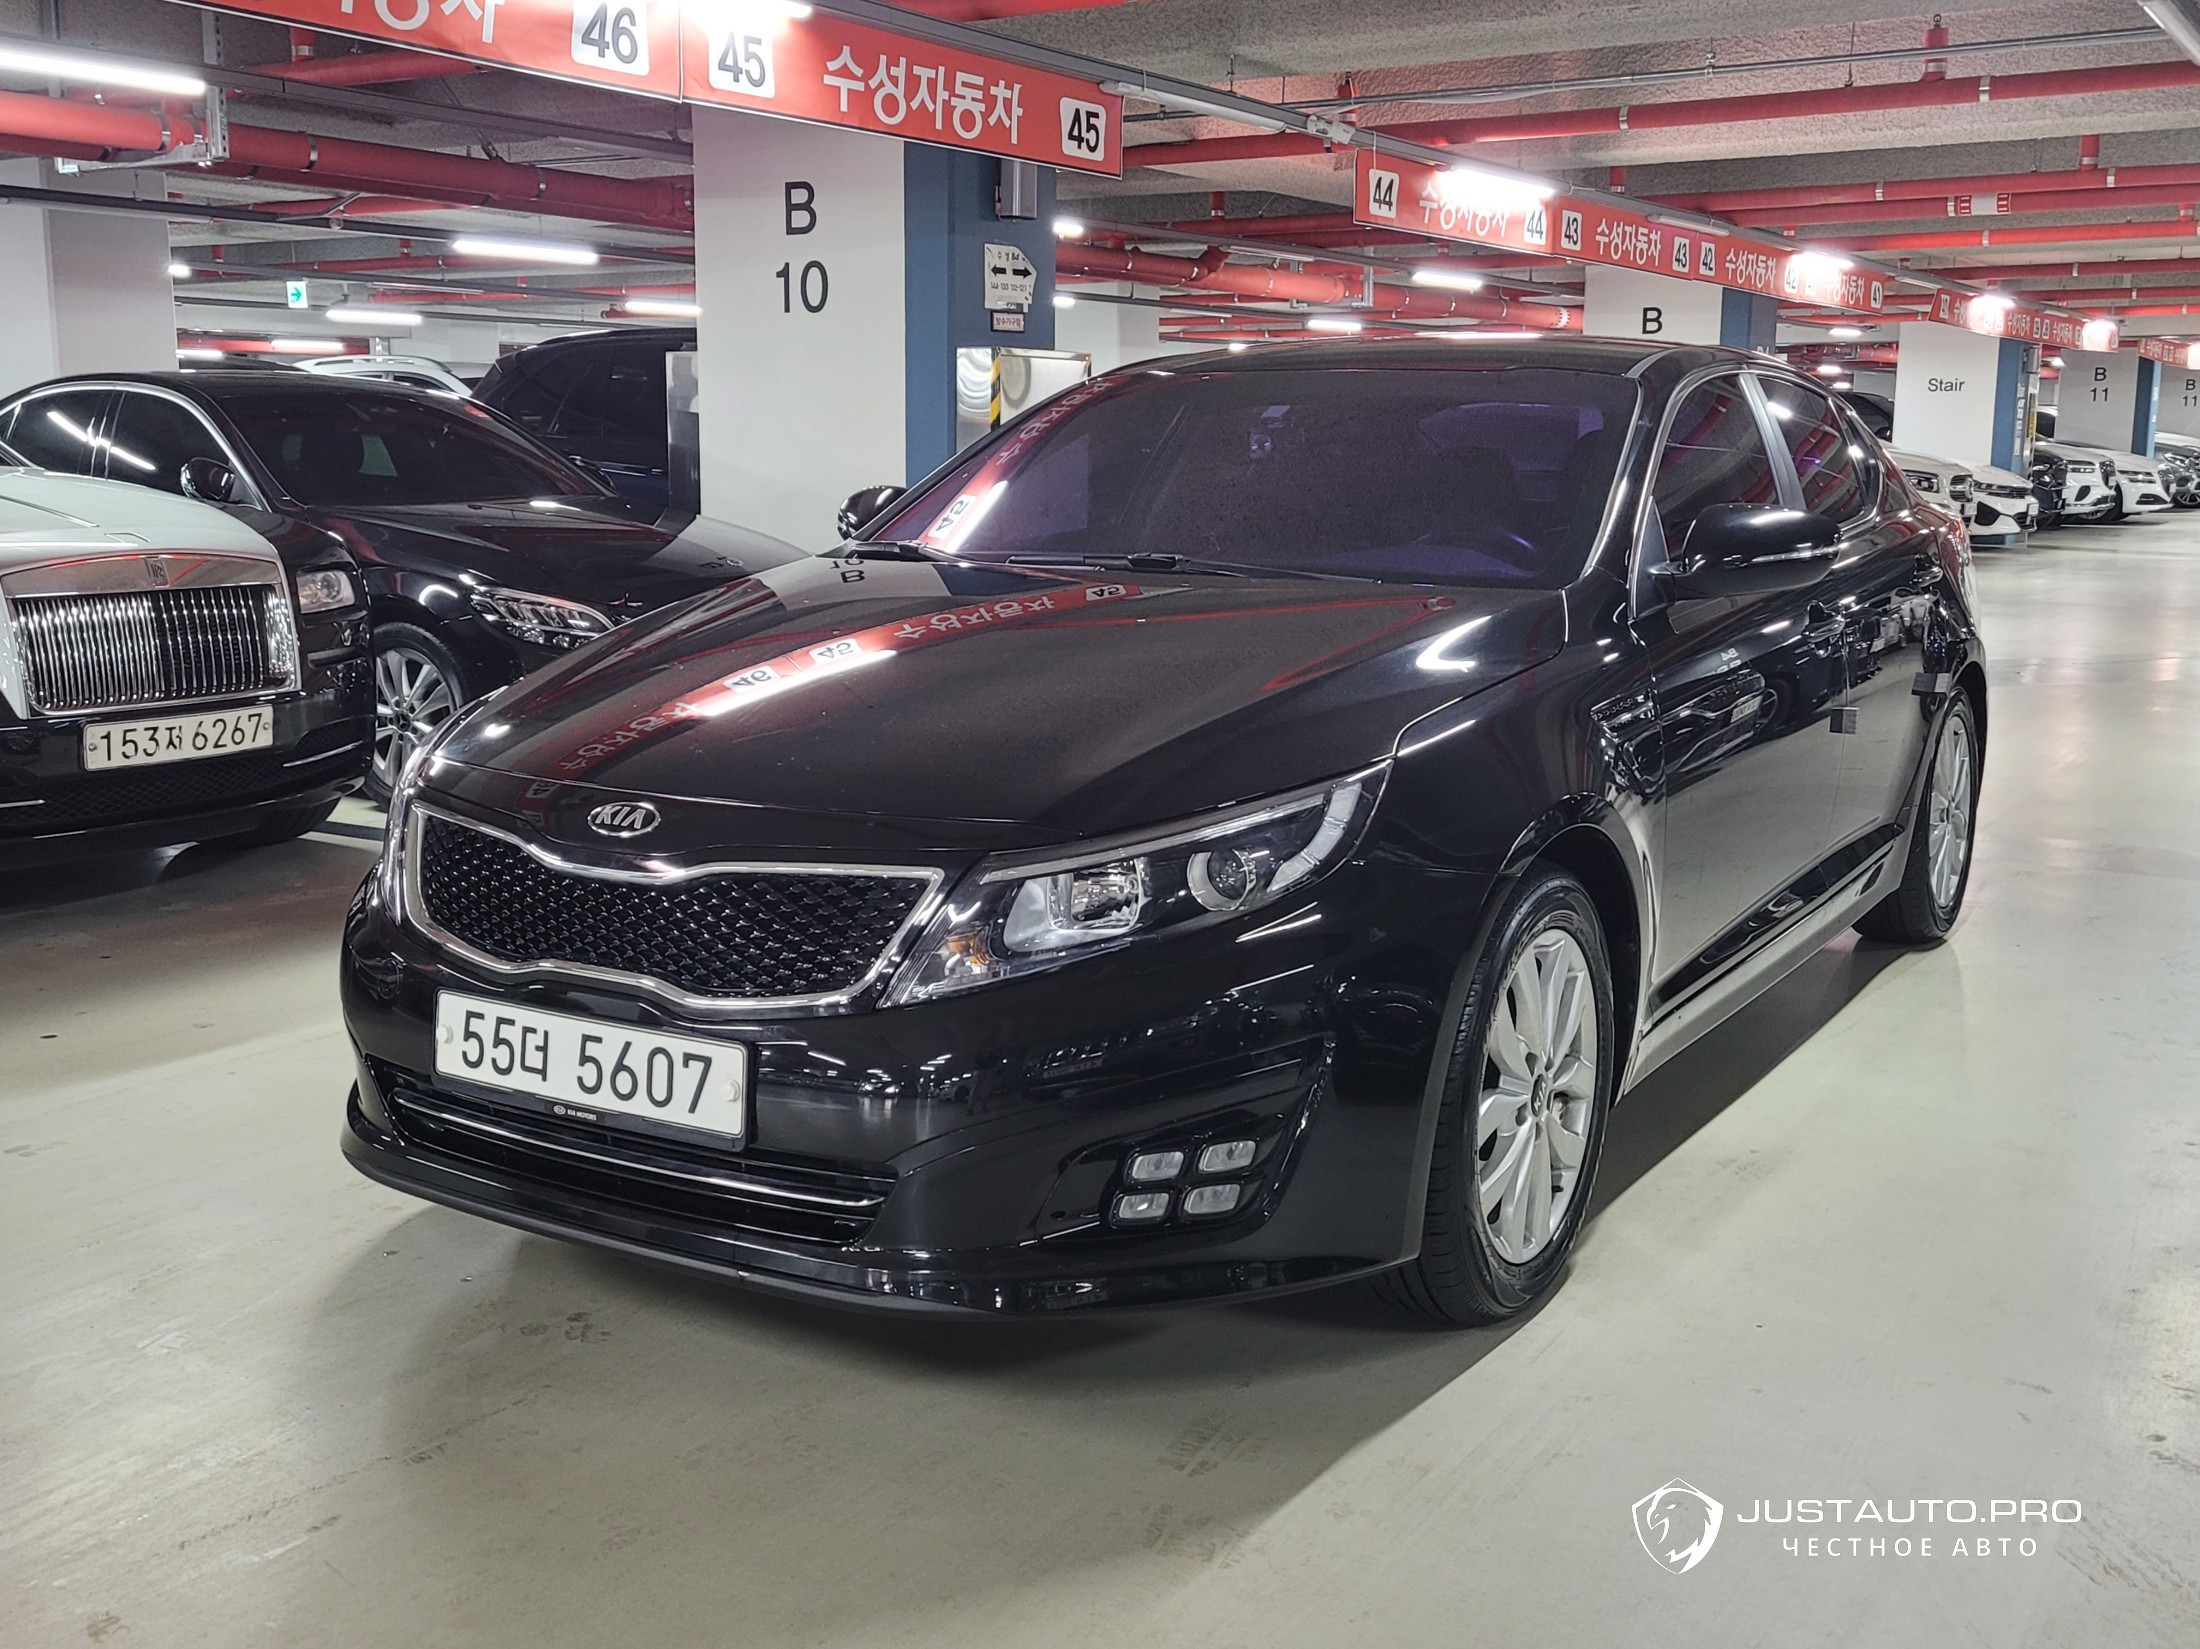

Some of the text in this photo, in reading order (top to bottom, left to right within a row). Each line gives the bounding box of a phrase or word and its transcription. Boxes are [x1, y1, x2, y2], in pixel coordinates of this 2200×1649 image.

[580, 6, 640, 65] 46
[717, 31, 1100, 153] 45 수성자동차 45
[785, 180, 817, 235] B
[1373, 176, 1394, 211] 44
[1526, 209, 1544, 240] 44
[1564, 216, 1688, 269] 43 수성자동차 43
[1702, 246, 1797, 290] 42 수성자동차 42
[775, 260, 829, 313] 10
[1872, 285, 1881, 305] 41
[1642, 306, 1663, 335] B
[1927, 377, 1966, 392] Stair
[2094, 367, 2107, 381] B
[2185, 379, 2196, 391] B
[2090, 387, 2109, 402] 11
[2182, 395, 2198, 407] 11
[594, 804, 647, 830] KIA
[461, 1009, 713, 1114] 55더 5607
[1533, 1081, 1547, 1112] KIA
